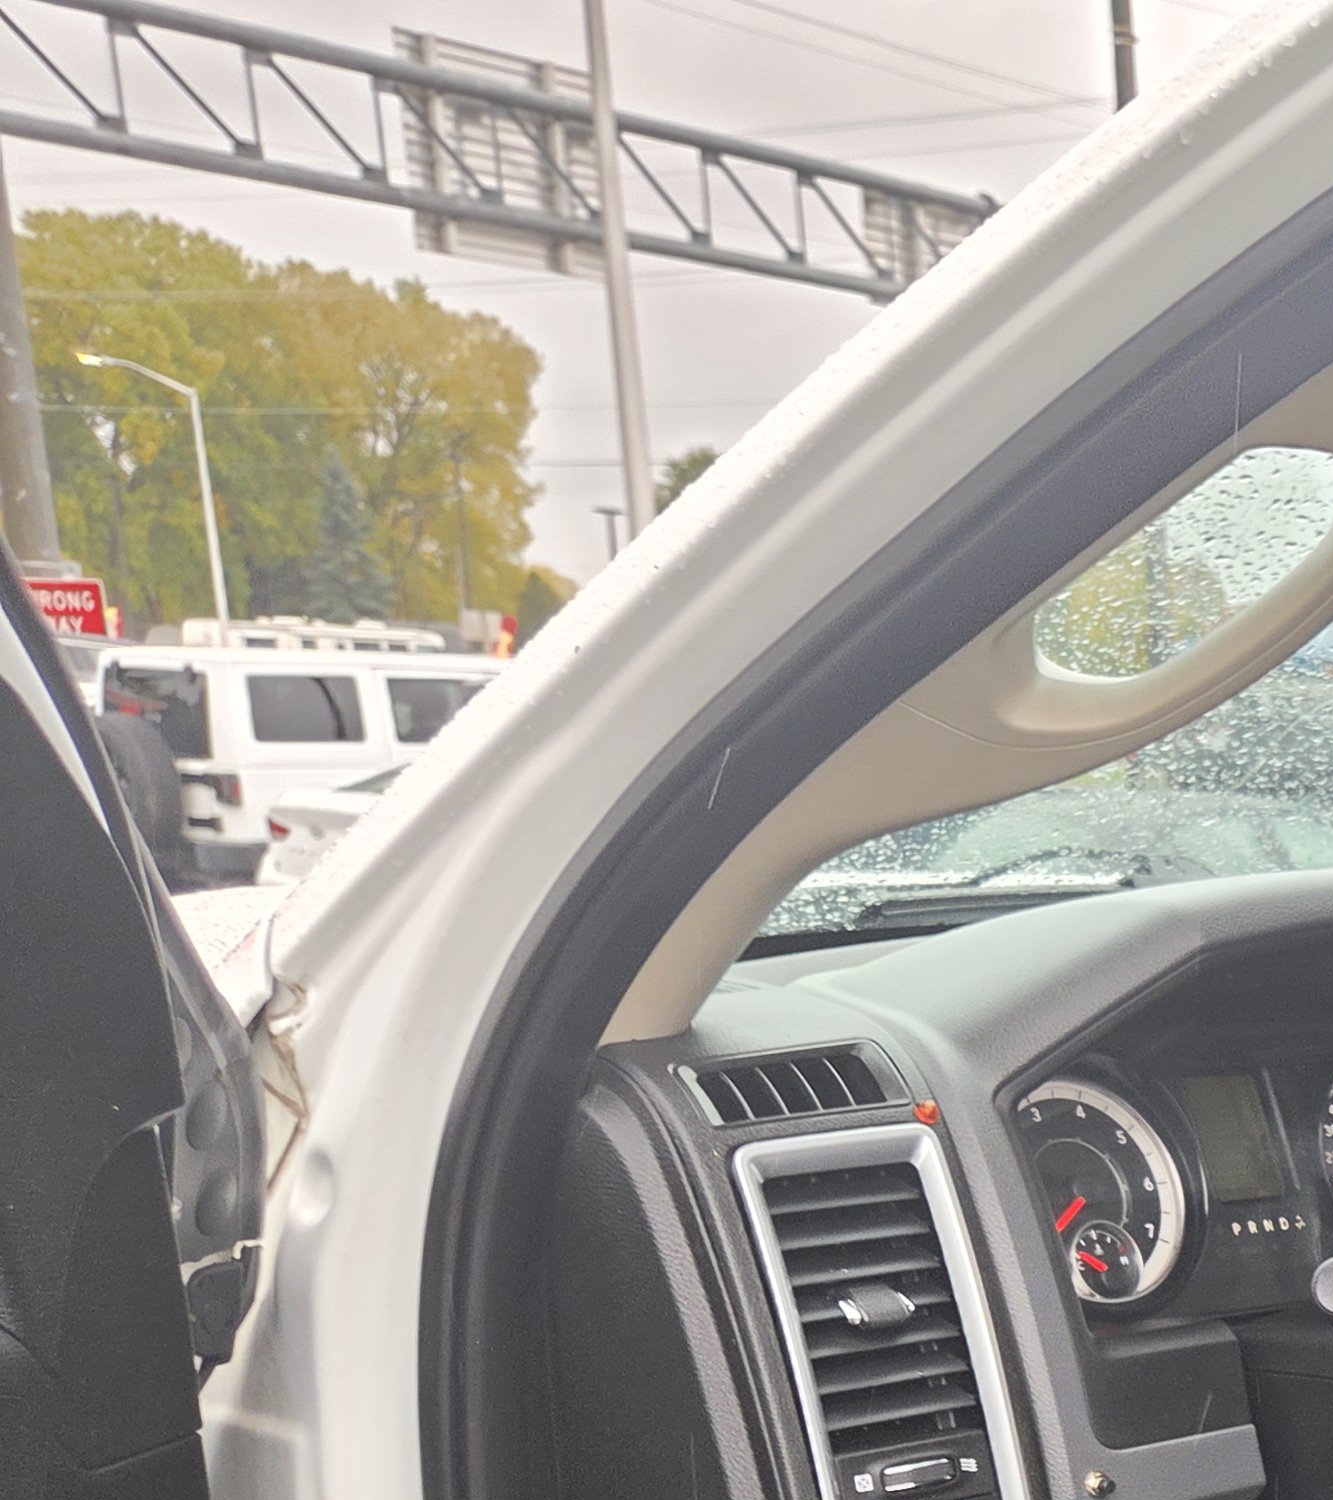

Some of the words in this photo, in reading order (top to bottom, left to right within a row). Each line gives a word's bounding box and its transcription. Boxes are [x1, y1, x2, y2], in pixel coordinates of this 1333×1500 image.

[47, 615, 84, 634] AY
[1030, 1107, 1042, 1123] 3
[1076, 1104, 1086, 1119] 4
[1115, 1130, 1127, 1145] 5
[1143, 1176, 1154, 1191] 6
[1143, 1223, 1155, 1239] 7
[1231, 1221, 1242, 1236] P
[1247, 1220, 1259, 1234] R
[1262, 1218, 1275, 1232] N
[1279, 1216, 1290, 1231] D
